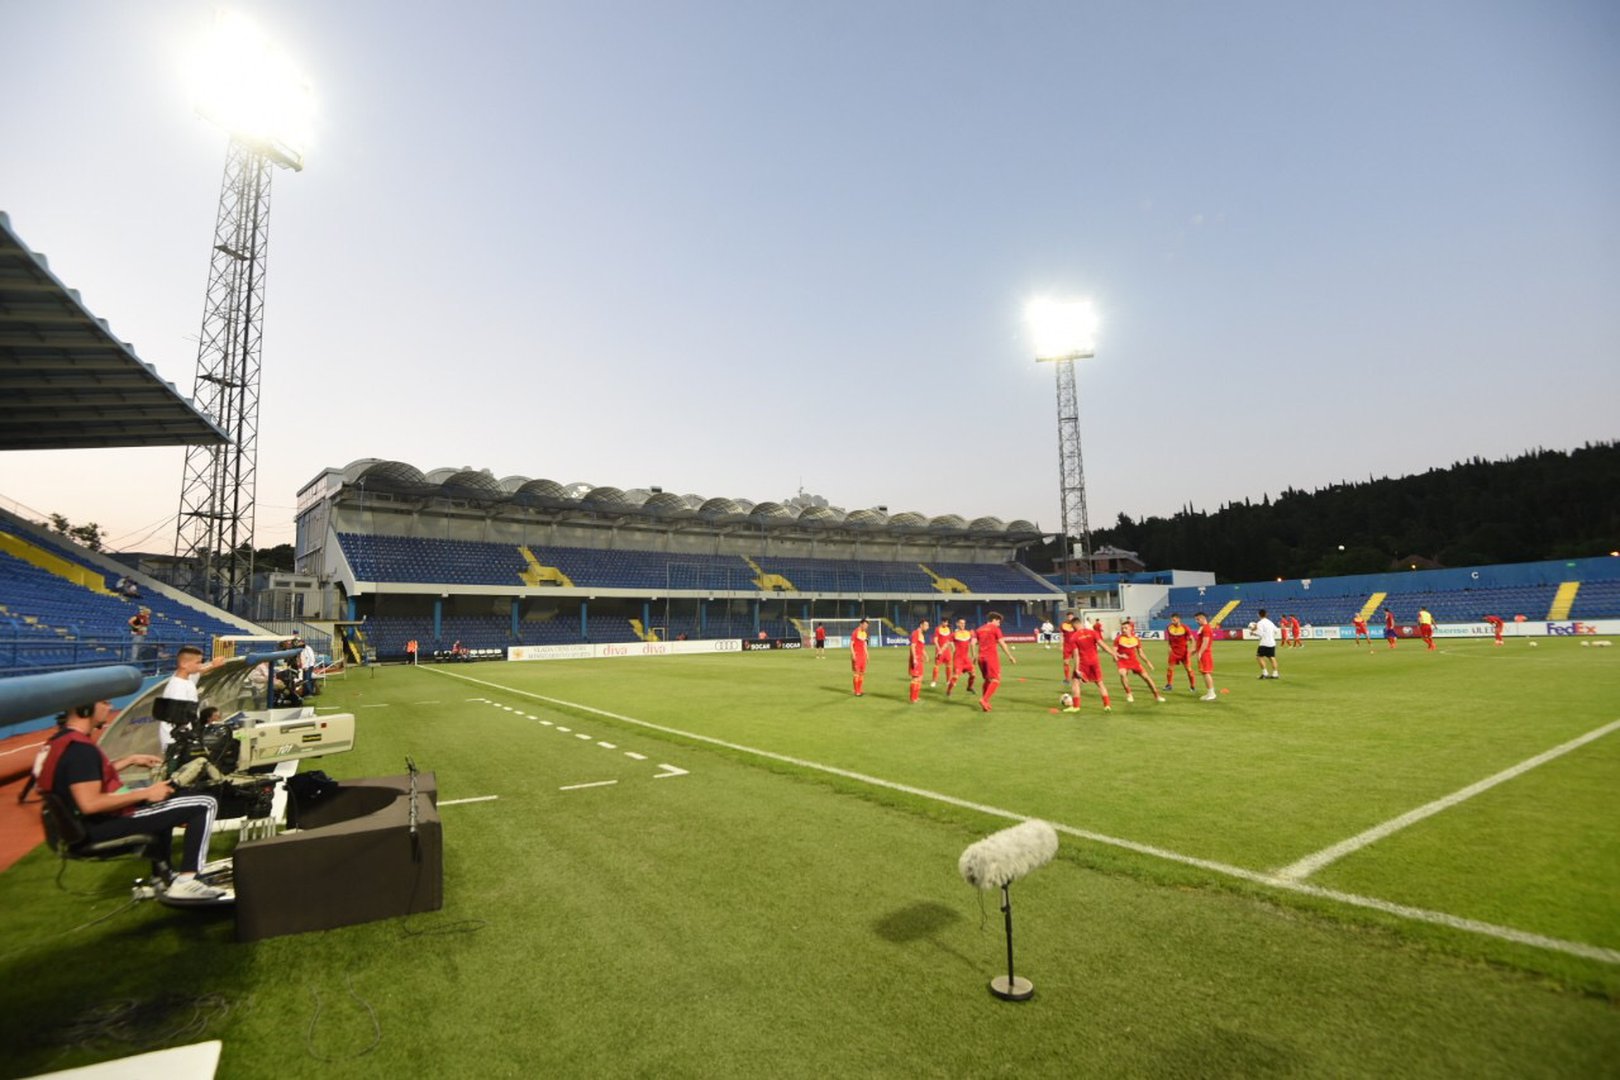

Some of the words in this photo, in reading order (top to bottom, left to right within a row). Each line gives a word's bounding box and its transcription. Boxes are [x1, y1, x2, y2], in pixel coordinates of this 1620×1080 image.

[1471, 571, 1479, 580] C
[1546, 622, 1597, 636] FedEx
[603, 645, 628, 656] diva
[643, 643, 666, 654] diva
